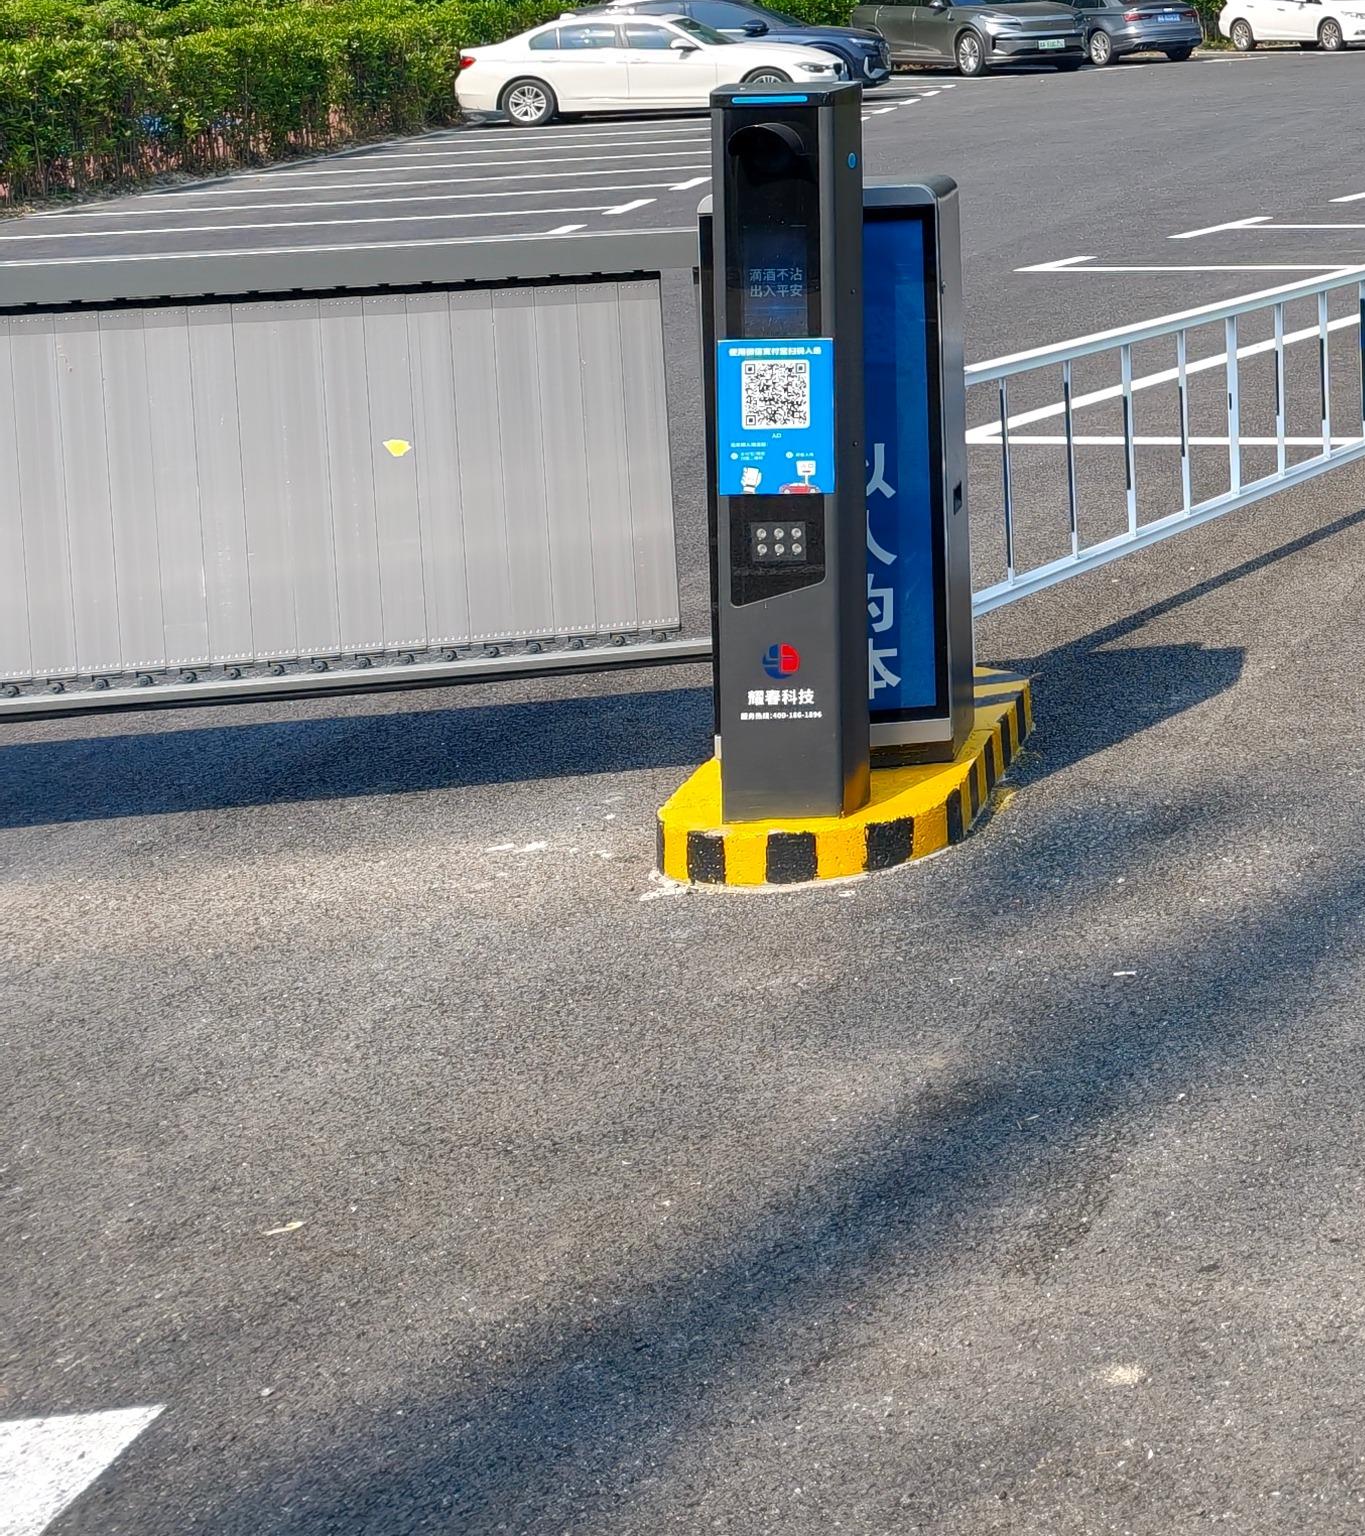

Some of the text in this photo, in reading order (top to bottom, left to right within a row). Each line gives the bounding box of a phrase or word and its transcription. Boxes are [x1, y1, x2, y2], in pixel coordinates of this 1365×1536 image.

[749, 267, 803, 282] 滴酒不沾
[750, 284, 803, 298] 出入平安
